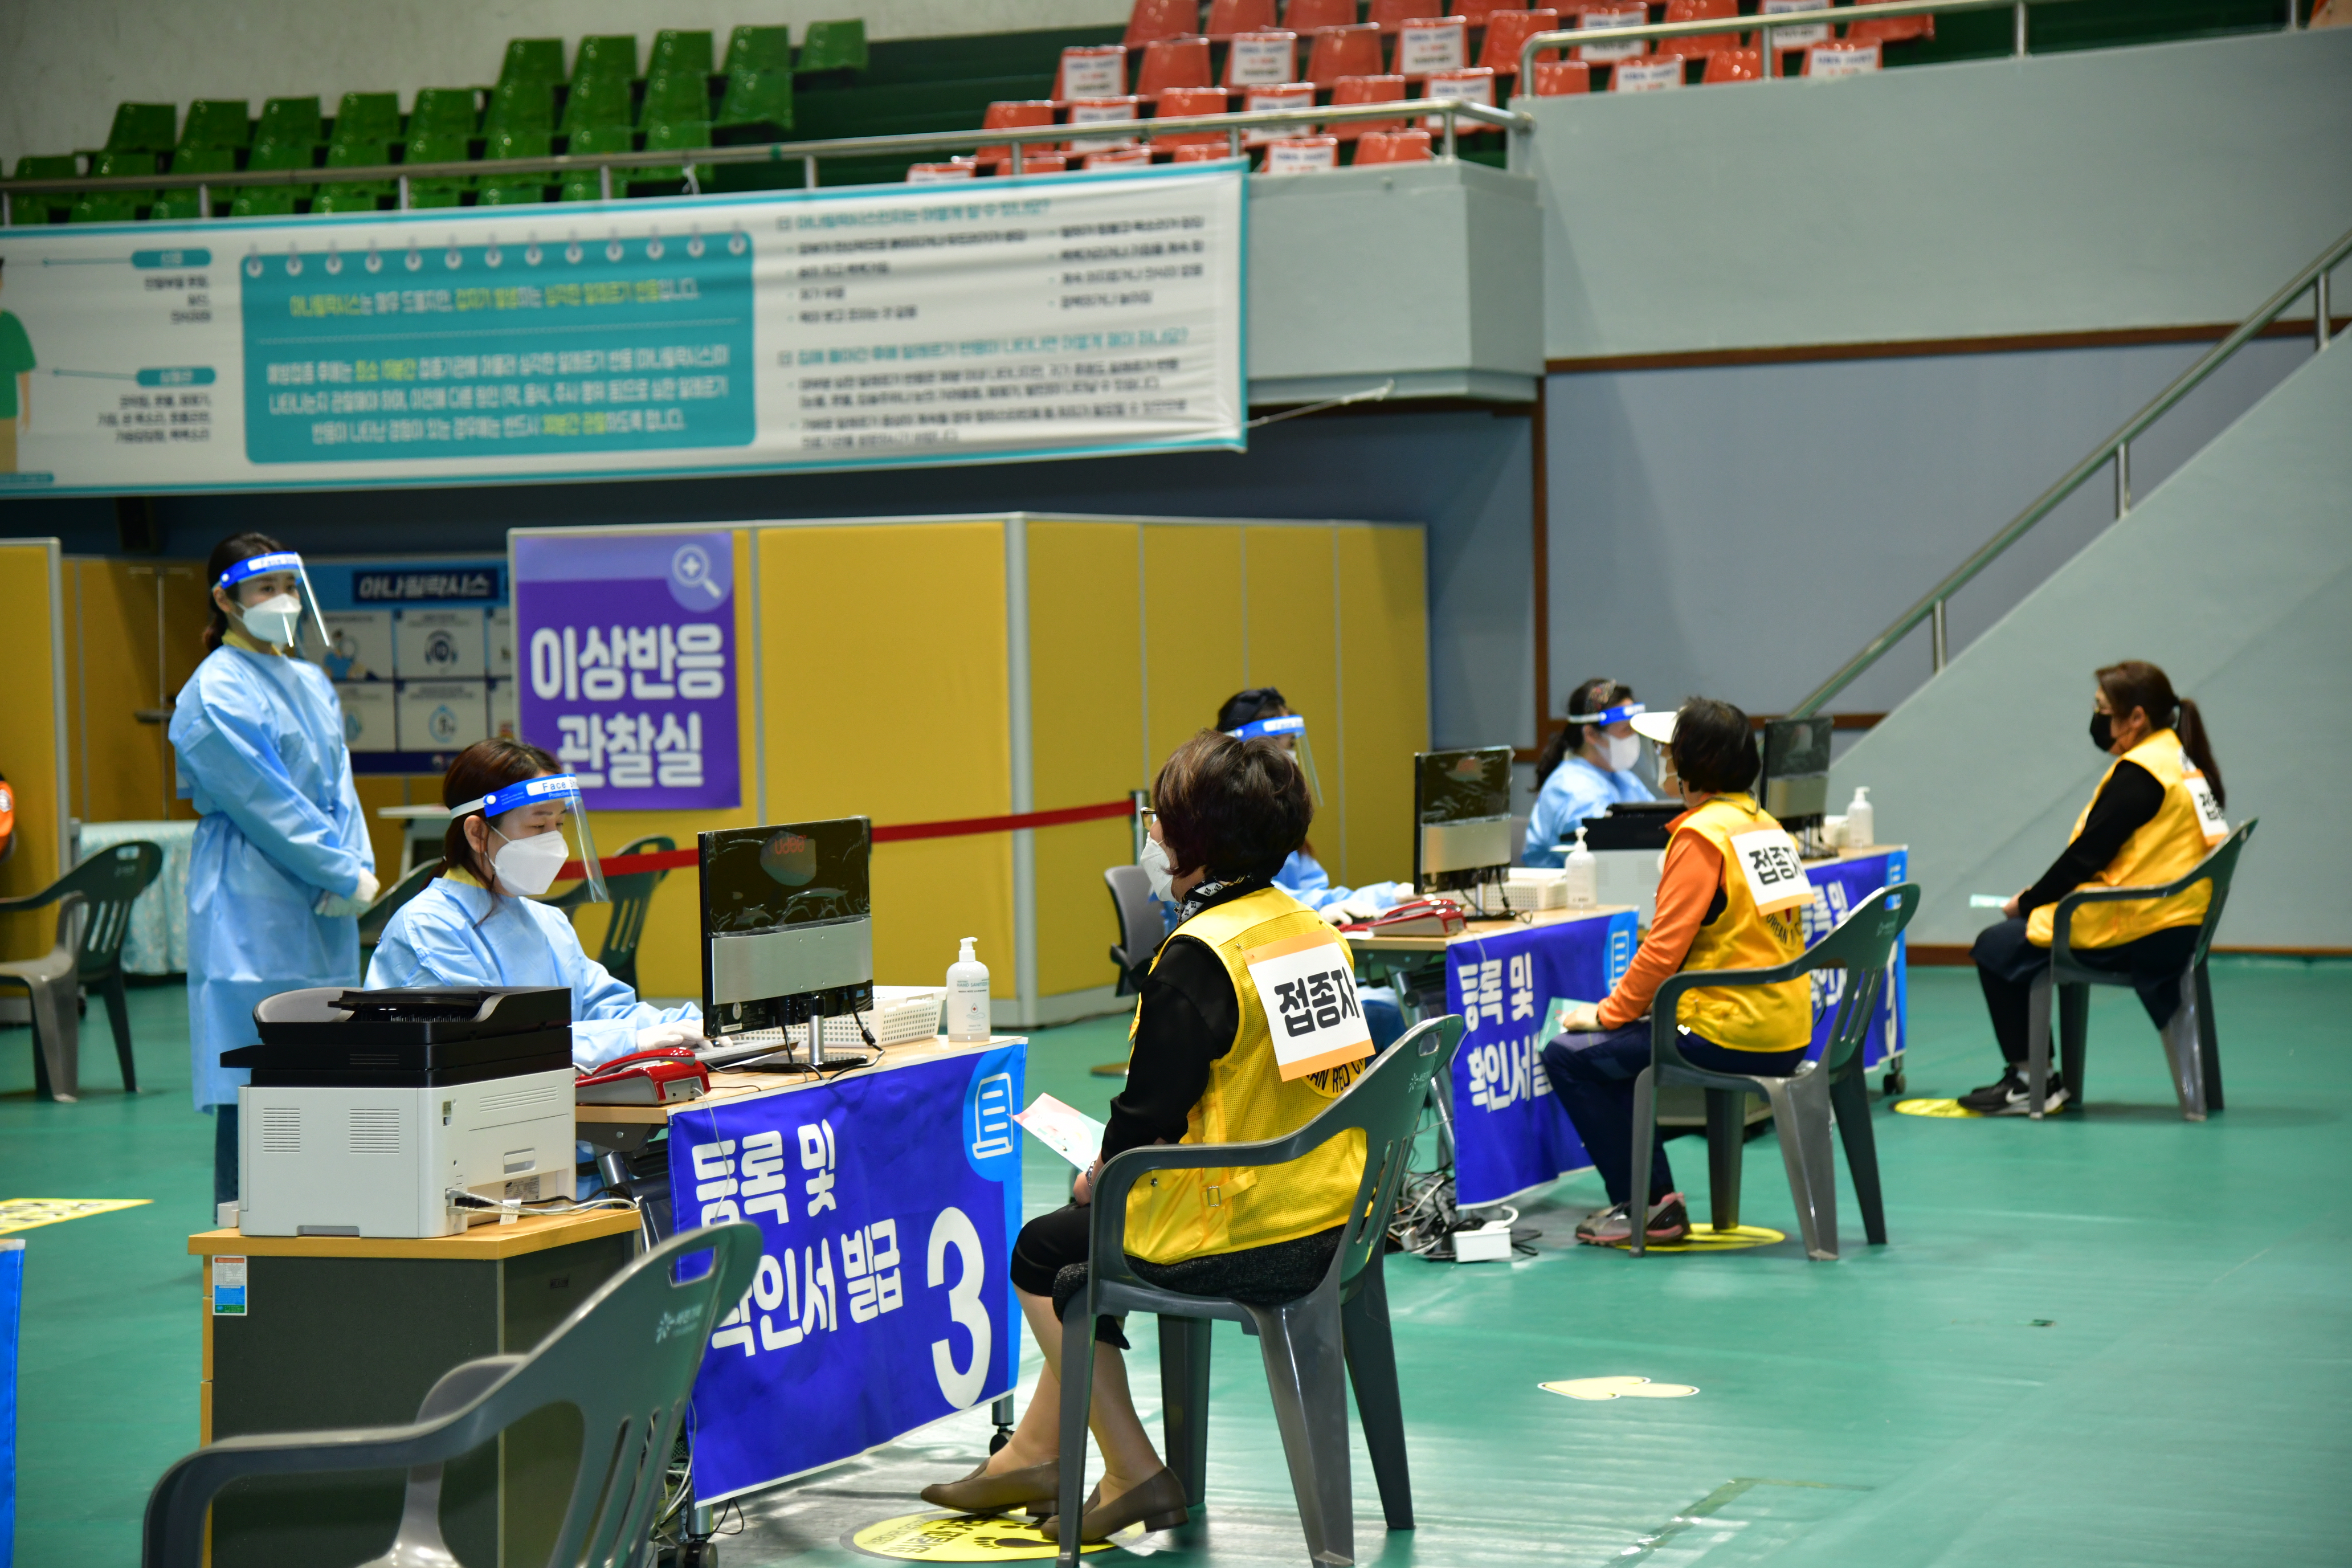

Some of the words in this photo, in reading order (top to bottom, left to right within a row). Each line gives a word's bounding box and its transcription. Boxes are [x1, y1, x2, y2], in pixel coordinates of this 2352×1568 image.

[358, 570, 492, 599] 아나필락시스
[530, 622, 725, 701] 이상반응
[542, 782, 566, 791] Face
[555, 711, 705, 789] 관찰실
[1274, 966, 1360, 1038] 접종자
[1457, 958, 1504, 1032] 등록
[1509, 952, 1534, 1022] 및
[1333, 1064, 1350, 1093] RED
[1467, 1034, 1531, 1113] 확인서
[691, 1129, 790, 1225] 등록
[797, 1118, 837, 1218] 및
[840, 1218, 904, 1324] 발급
[926, 1206, 992, 1411] 3
